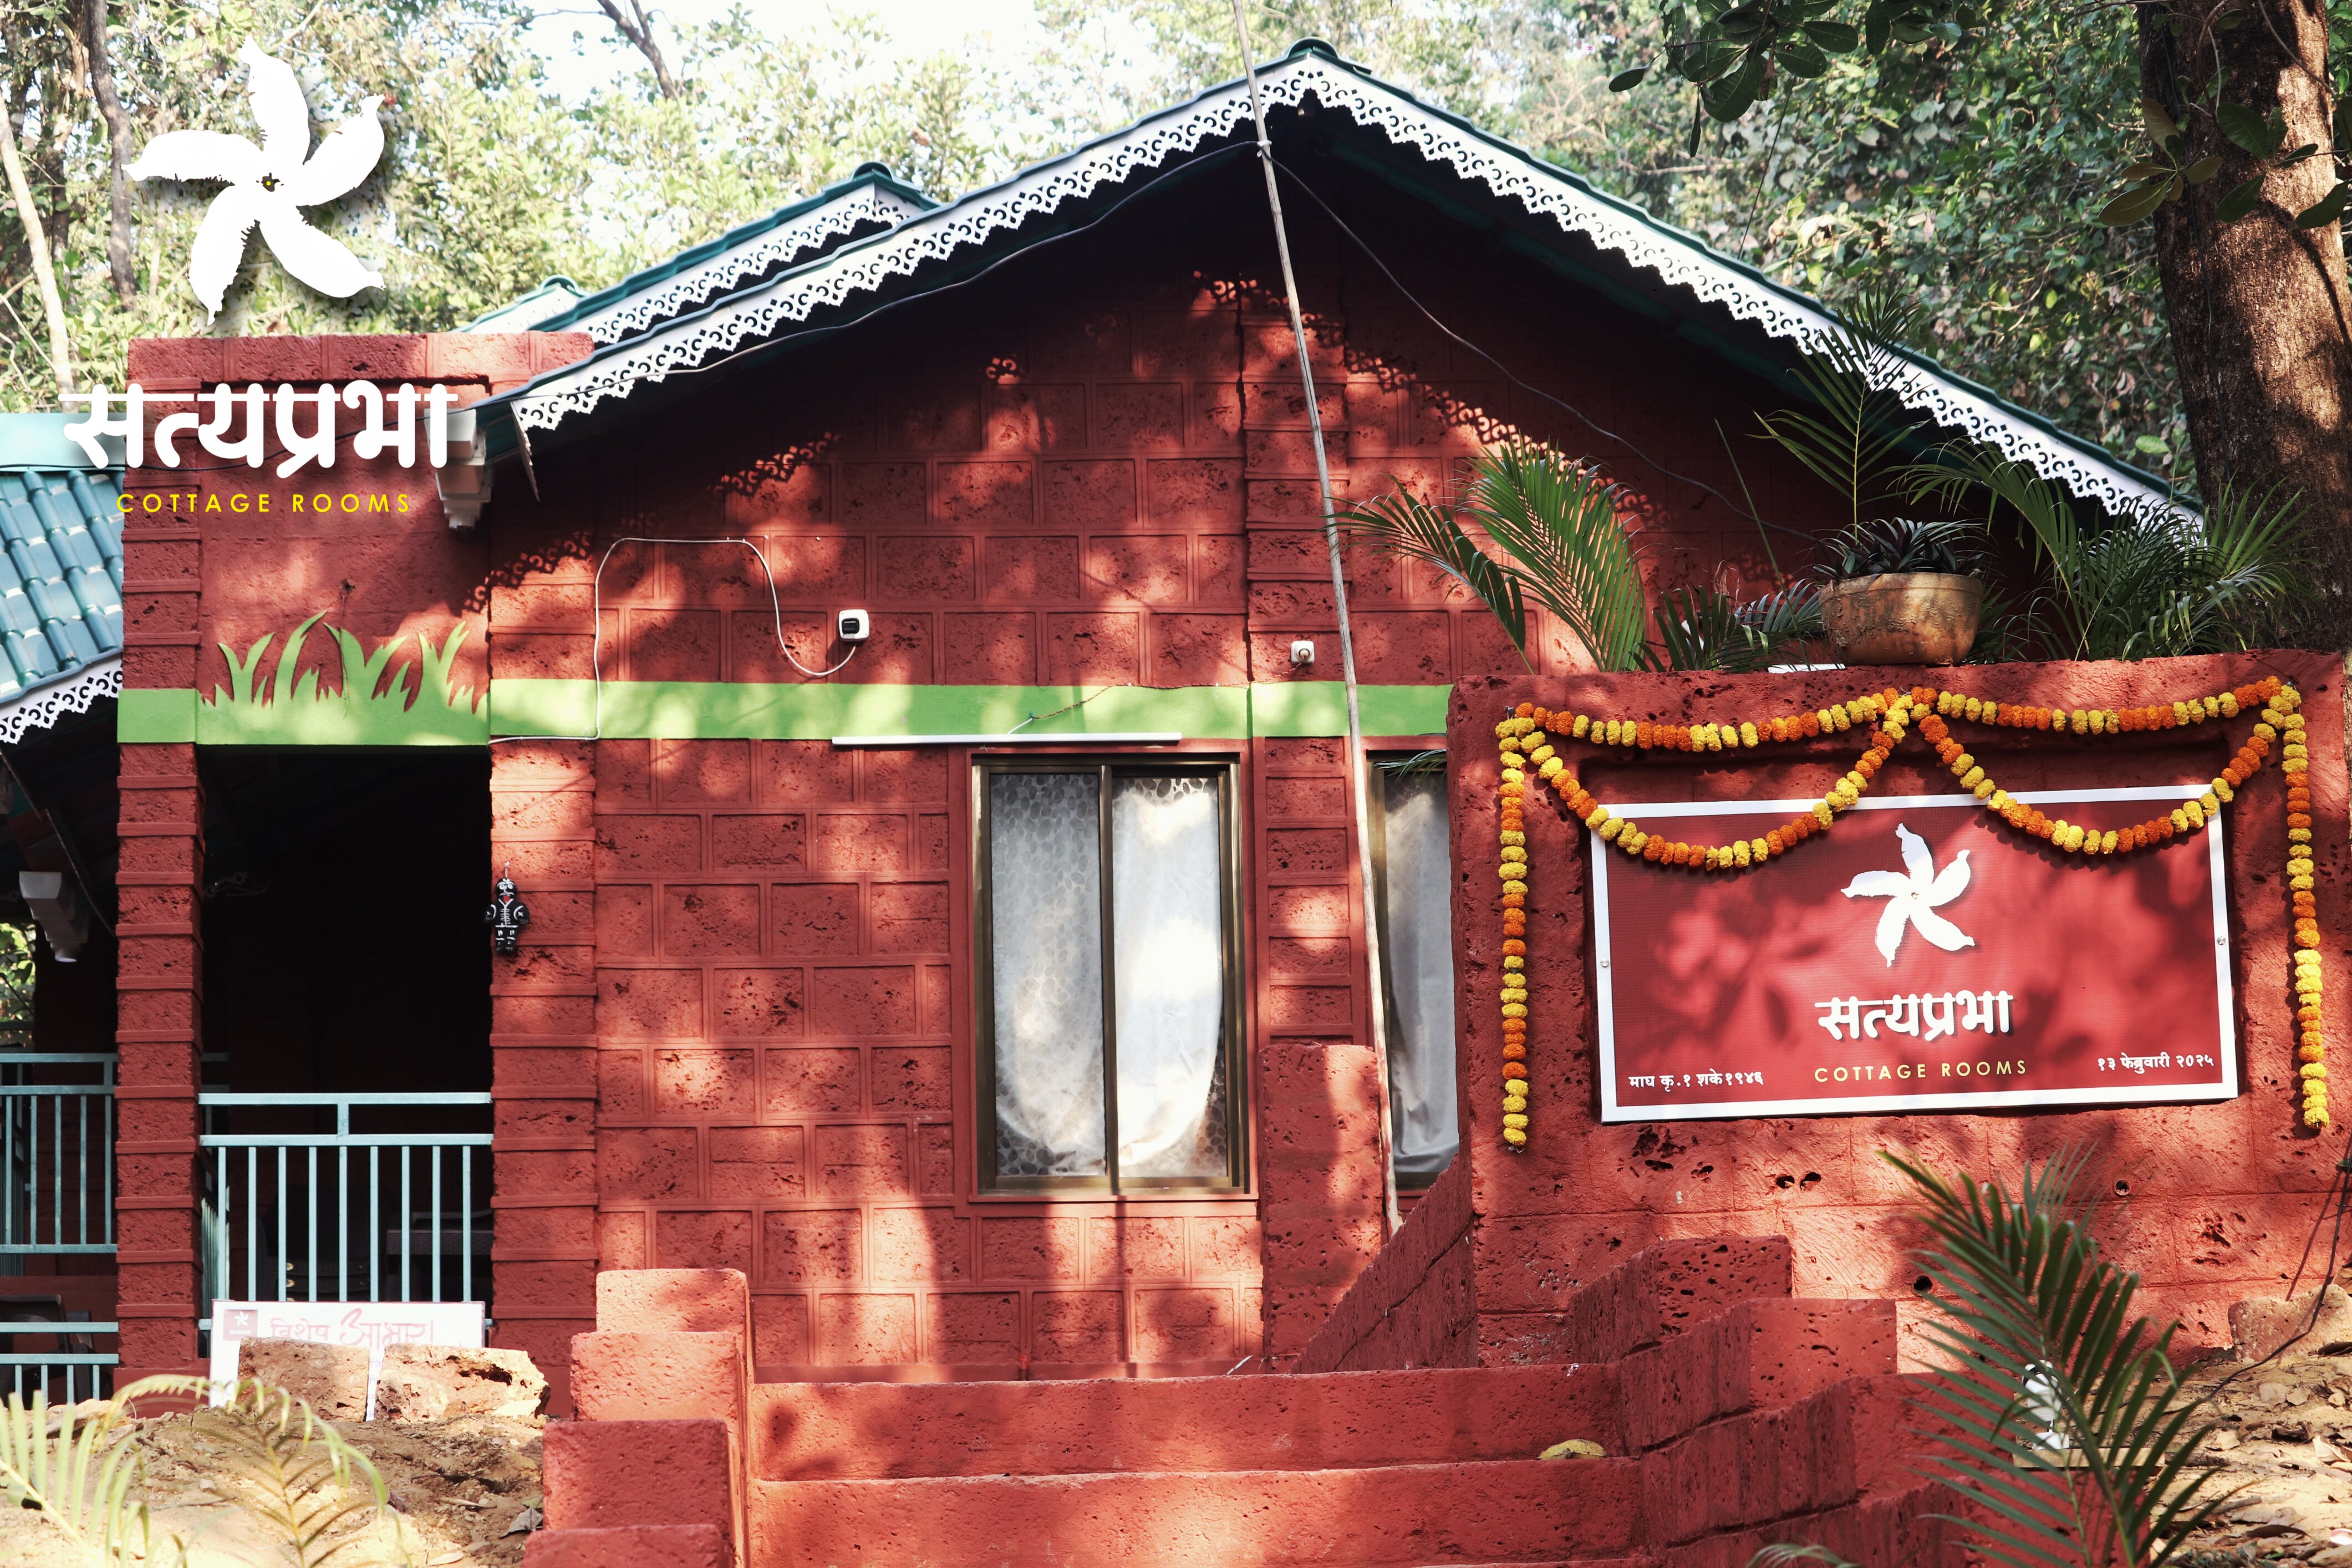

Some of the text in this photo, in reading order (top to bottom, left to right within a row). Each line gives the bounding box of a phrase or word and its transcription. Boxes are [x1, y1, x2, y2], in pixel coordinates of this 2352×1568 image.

[1814, 989, 2014, 1042] सत्यप्रभा
[1814, 1060, 2027, 1083] COTTAGE ROOMS
[2098, 1051, 2214, 1075] १३ फेब्रुवारी २०२५
[1628, 1076, 1656, 1088] माघ
